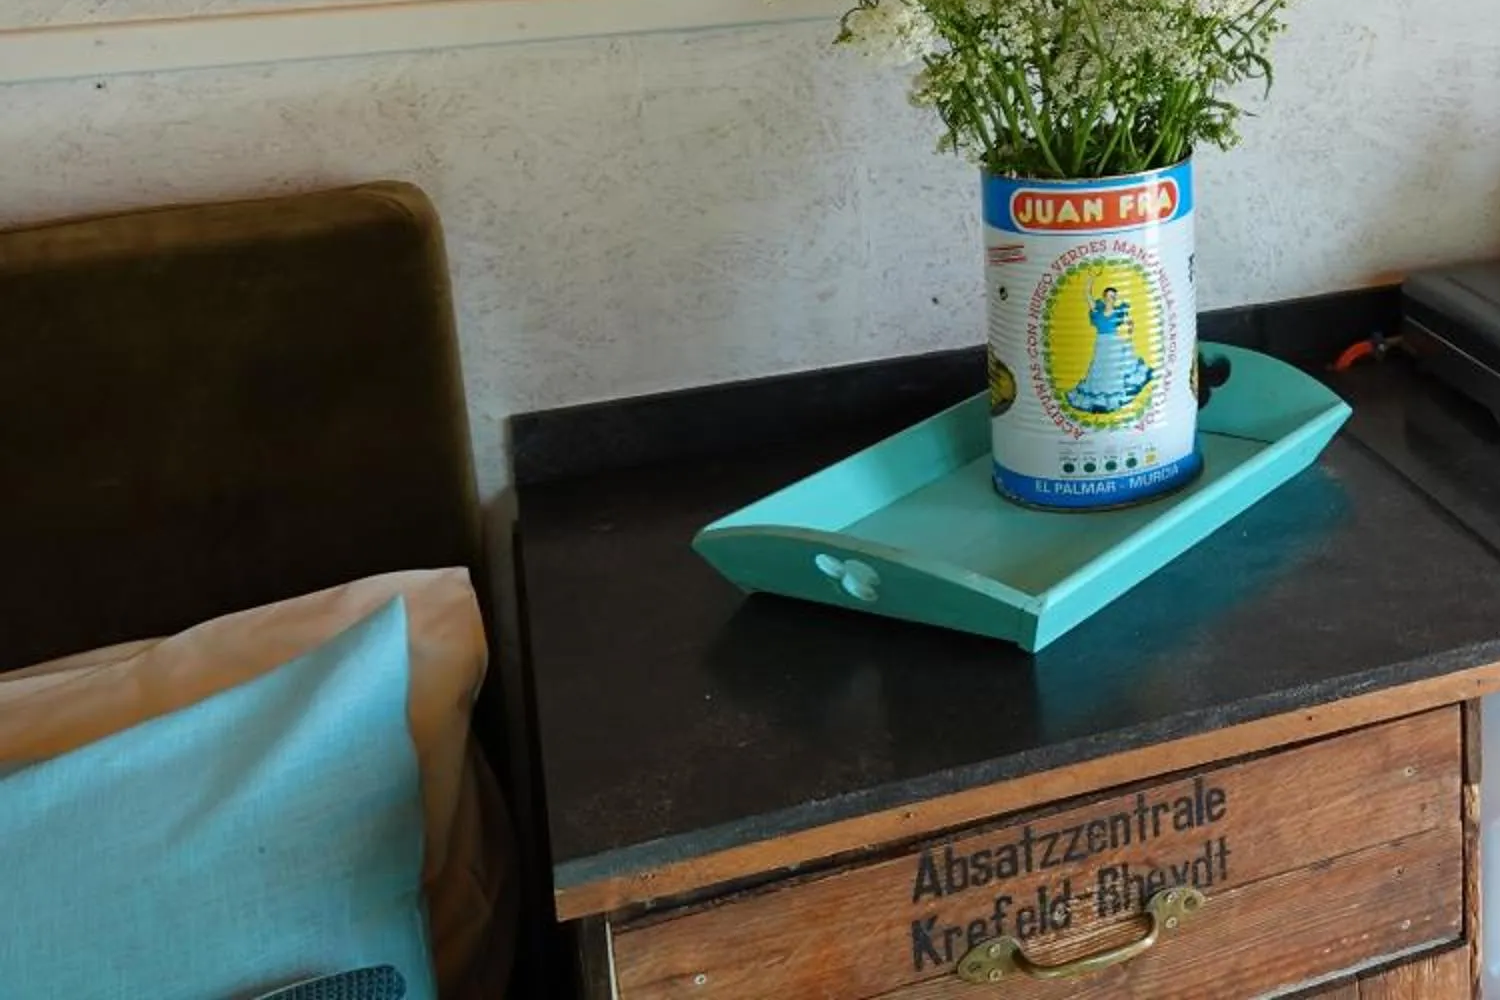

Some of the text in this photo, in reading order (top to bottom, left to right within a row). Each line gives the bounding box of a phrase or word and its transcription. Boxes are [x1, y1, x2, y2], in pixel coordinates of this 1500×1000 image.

[1018, 187, 1173, 224] JUAN FRA
[1027, 323, 1039, 358] CON
[1051, 239, 1107, 272] VERDES
[1035, 480, 1051, 494] EL
[1053, 480, 1117, 496] PALMAR
[1128, 463, 1180, 490] MURCIA
[911, 776, 1228, 904] Absatzzentrale
